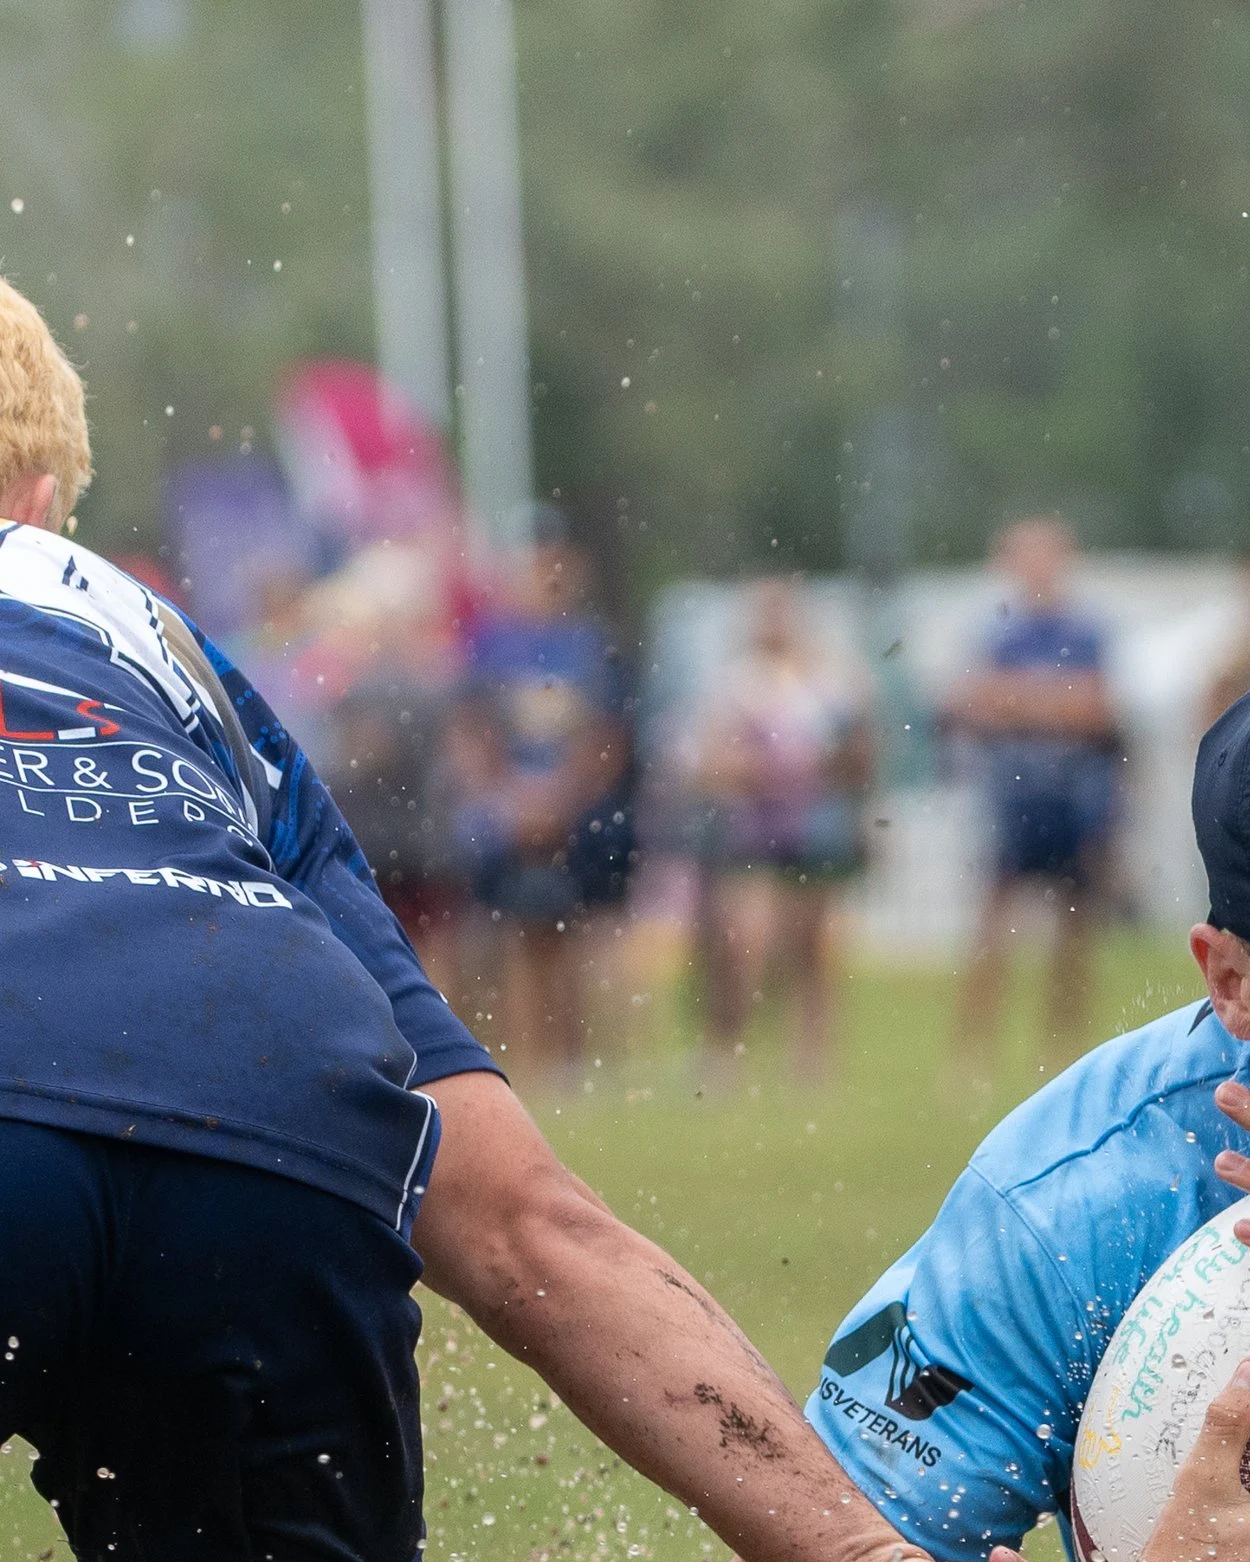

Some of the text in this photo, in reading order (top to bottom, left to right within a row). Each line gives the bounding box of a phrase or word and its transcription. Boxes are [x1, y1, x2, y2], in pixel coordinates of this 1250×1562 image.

[73, 757, 113, 789] &
[131, 749, 259, 838] SON
[1112, 1226, 1221, 1365] for life
[1121, 1289, 1206, 1422] health
